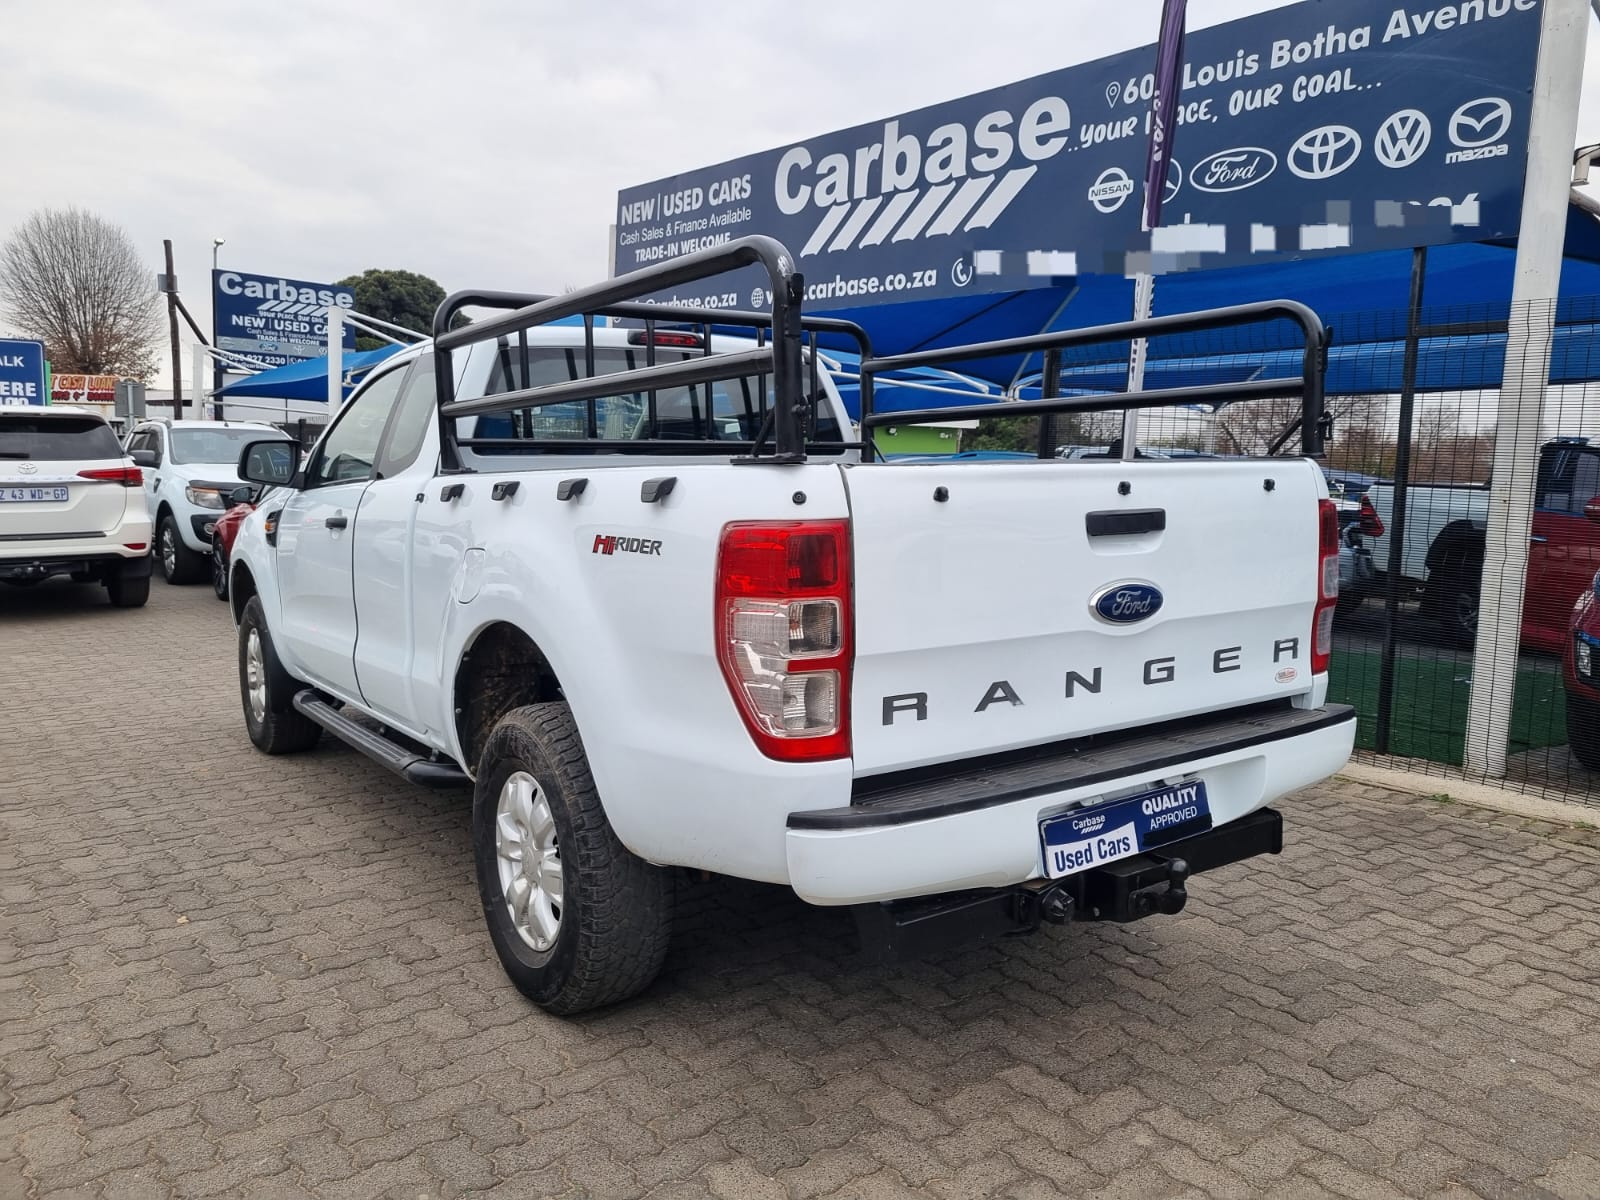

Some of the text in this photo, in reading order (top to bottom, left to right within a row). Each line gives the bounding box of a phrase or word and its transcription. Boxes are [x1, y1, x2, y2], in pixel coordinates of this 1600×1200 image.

[1182, 49, 1260, 90] Louis
[1270, 25, 1371, 69] Botha
[1229, 83, 1283, 116] OUR
[774, 96, 1071, 216] Carbase
[1204, 154, 1261, 185] Ford
[621, 174, 752, 226] NEW USED CARS
[1090, 183, 1131, 197] NISSAN
[620, 206, 752, 246] Cash Sales & Finance Available
[635, 242, 679, 263] TRADE-IN
[218, 272, 354, 309] Carbase
[231, 314, 347, 337] NEW USED CAS
[256, 334, 320, 346] TRADE-IN WELCOME
[265, 355, 286, 365] 2330
[59, 375, 86, 390] CASH
[11, 489, 24, 499] 43
[53, 488, 66, 499] GP
[1112, 590, 1152, 615] Ford
[882, 637, 1299, 726] RANGER
[1142, 785, 1198, 816] QUALITY
[1072, 814, 1106, 831] Carbase
[1150, 806, 1198, 831] APPROVED
[1055, 835, 1131, 873] Used Cars
